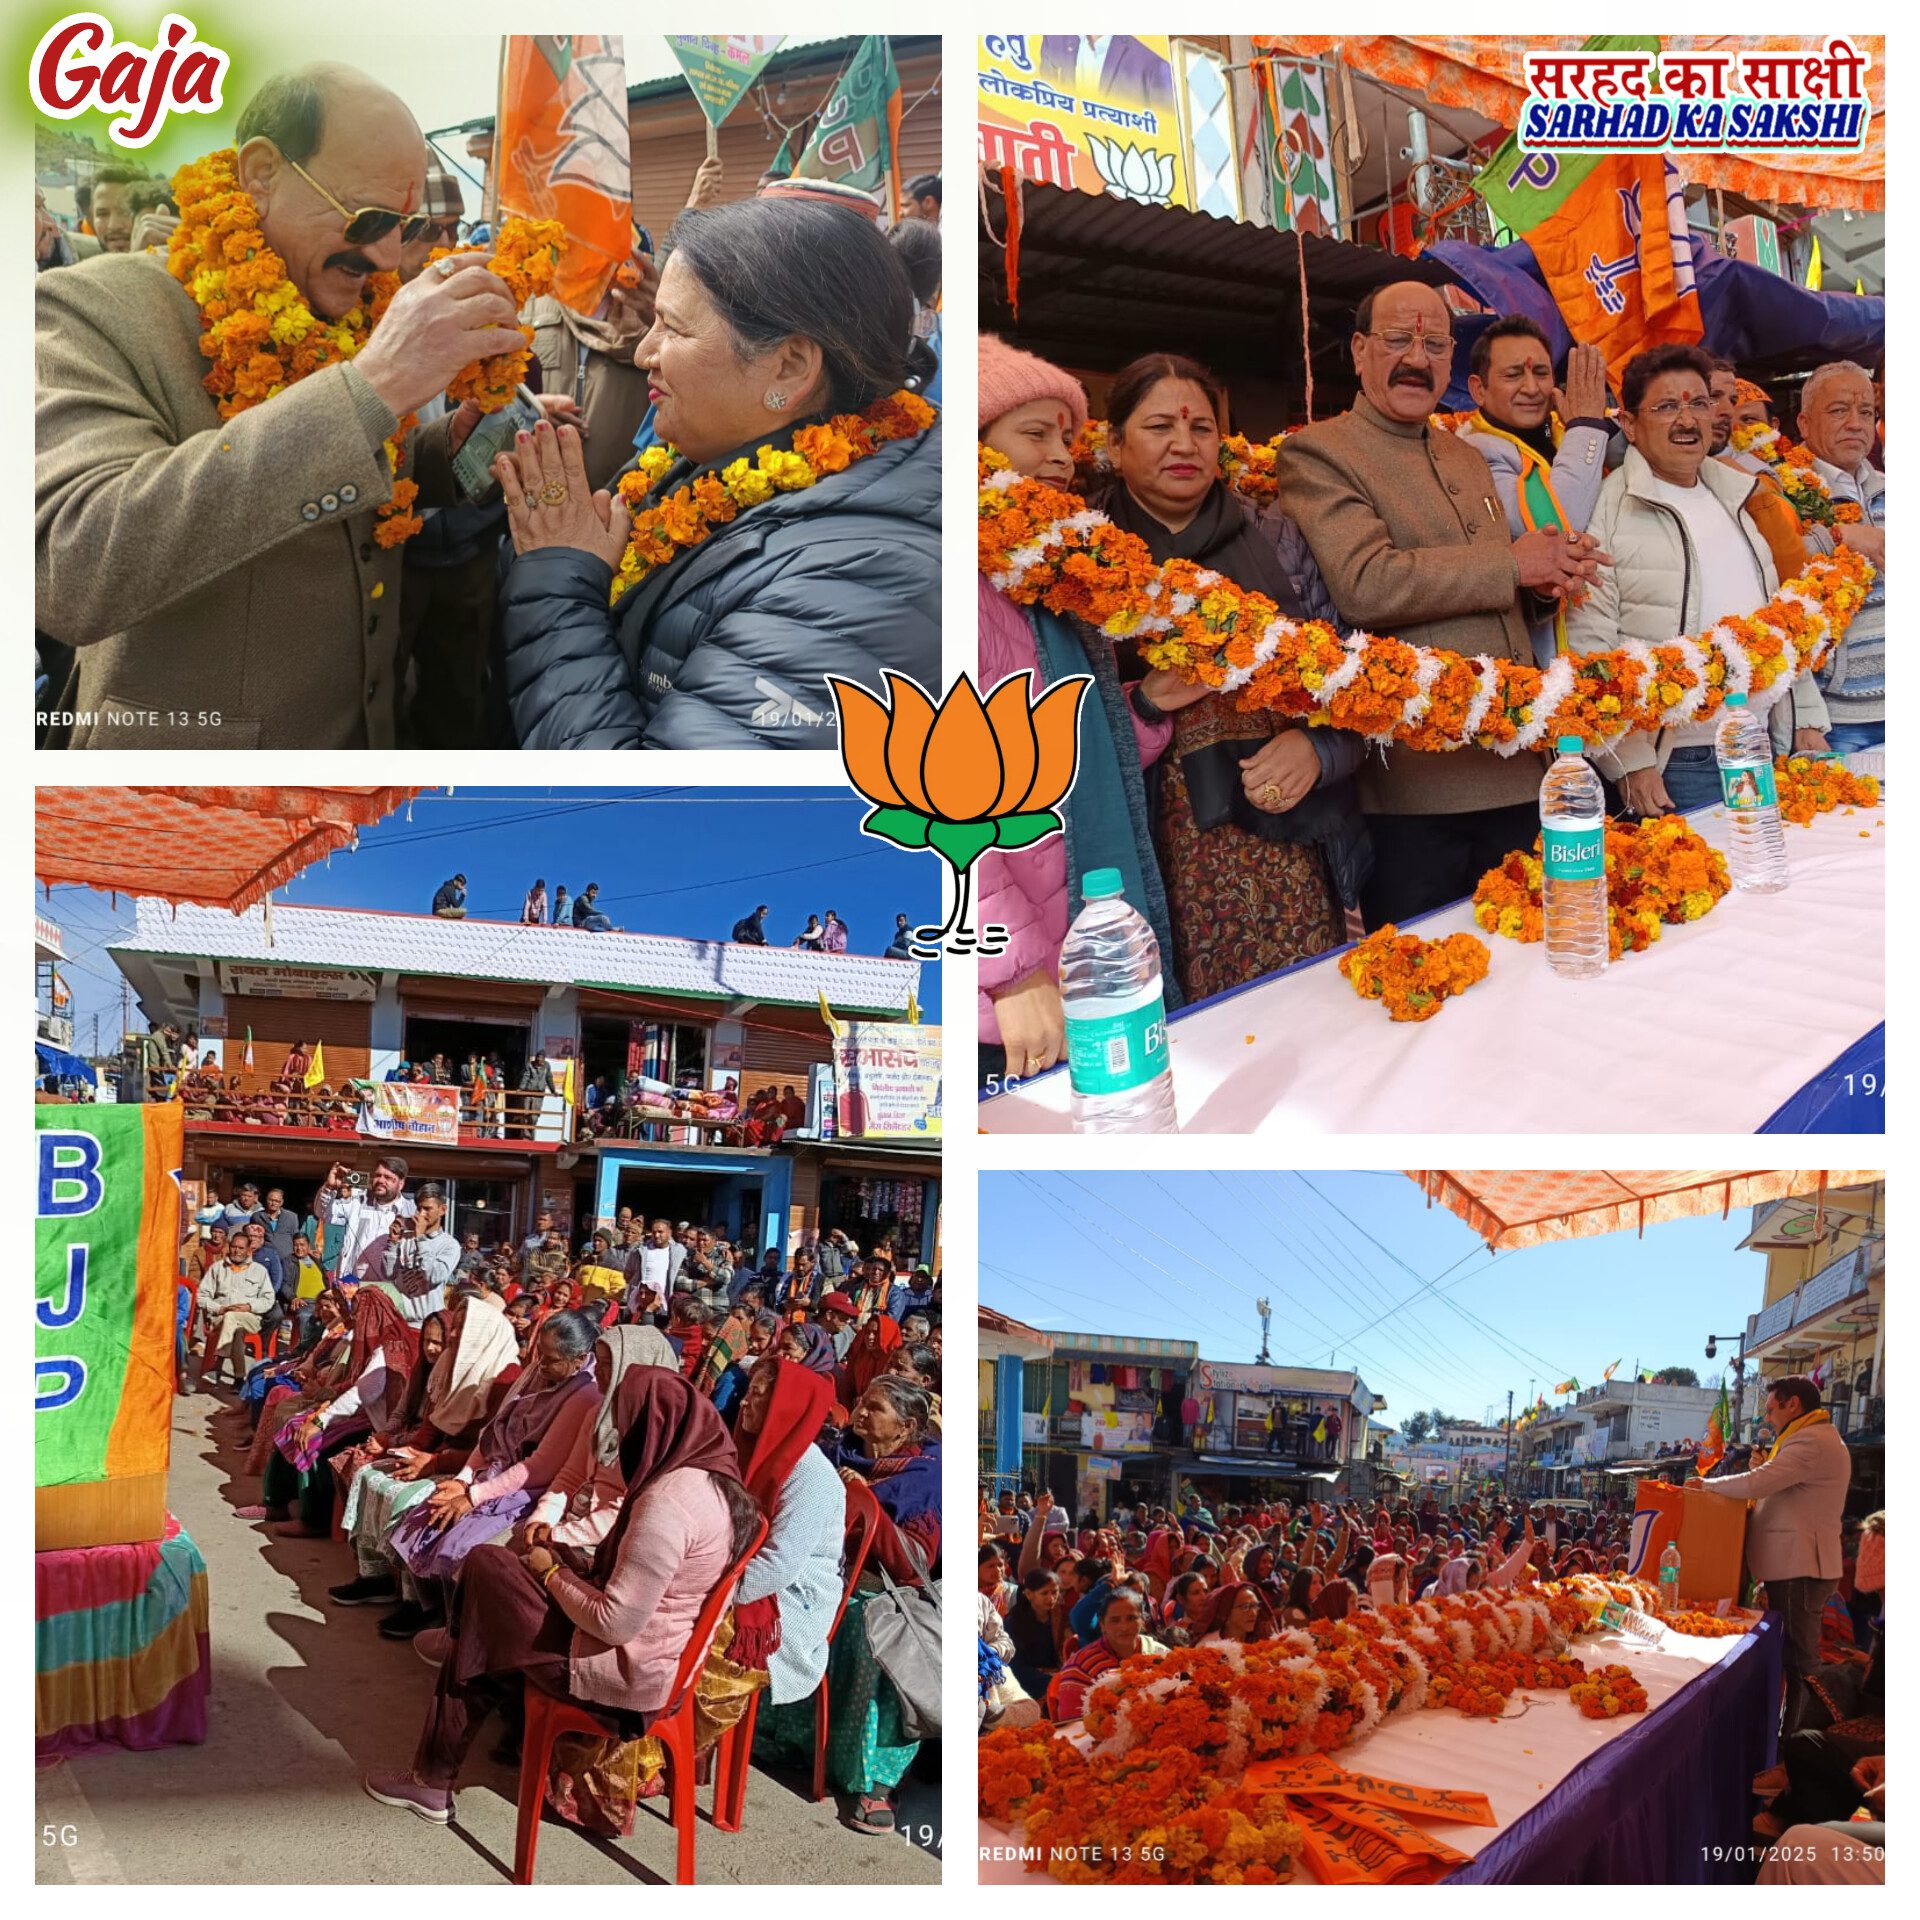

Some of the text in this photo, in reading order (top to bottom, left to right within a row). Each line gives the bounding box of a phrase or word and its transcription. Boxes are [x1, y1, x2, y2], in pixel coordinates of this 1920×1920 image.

[978, 69, 1158, 134] लोकप्रिय प्रत्याशी
[1551, 839, 1601, 862] Bisleri
